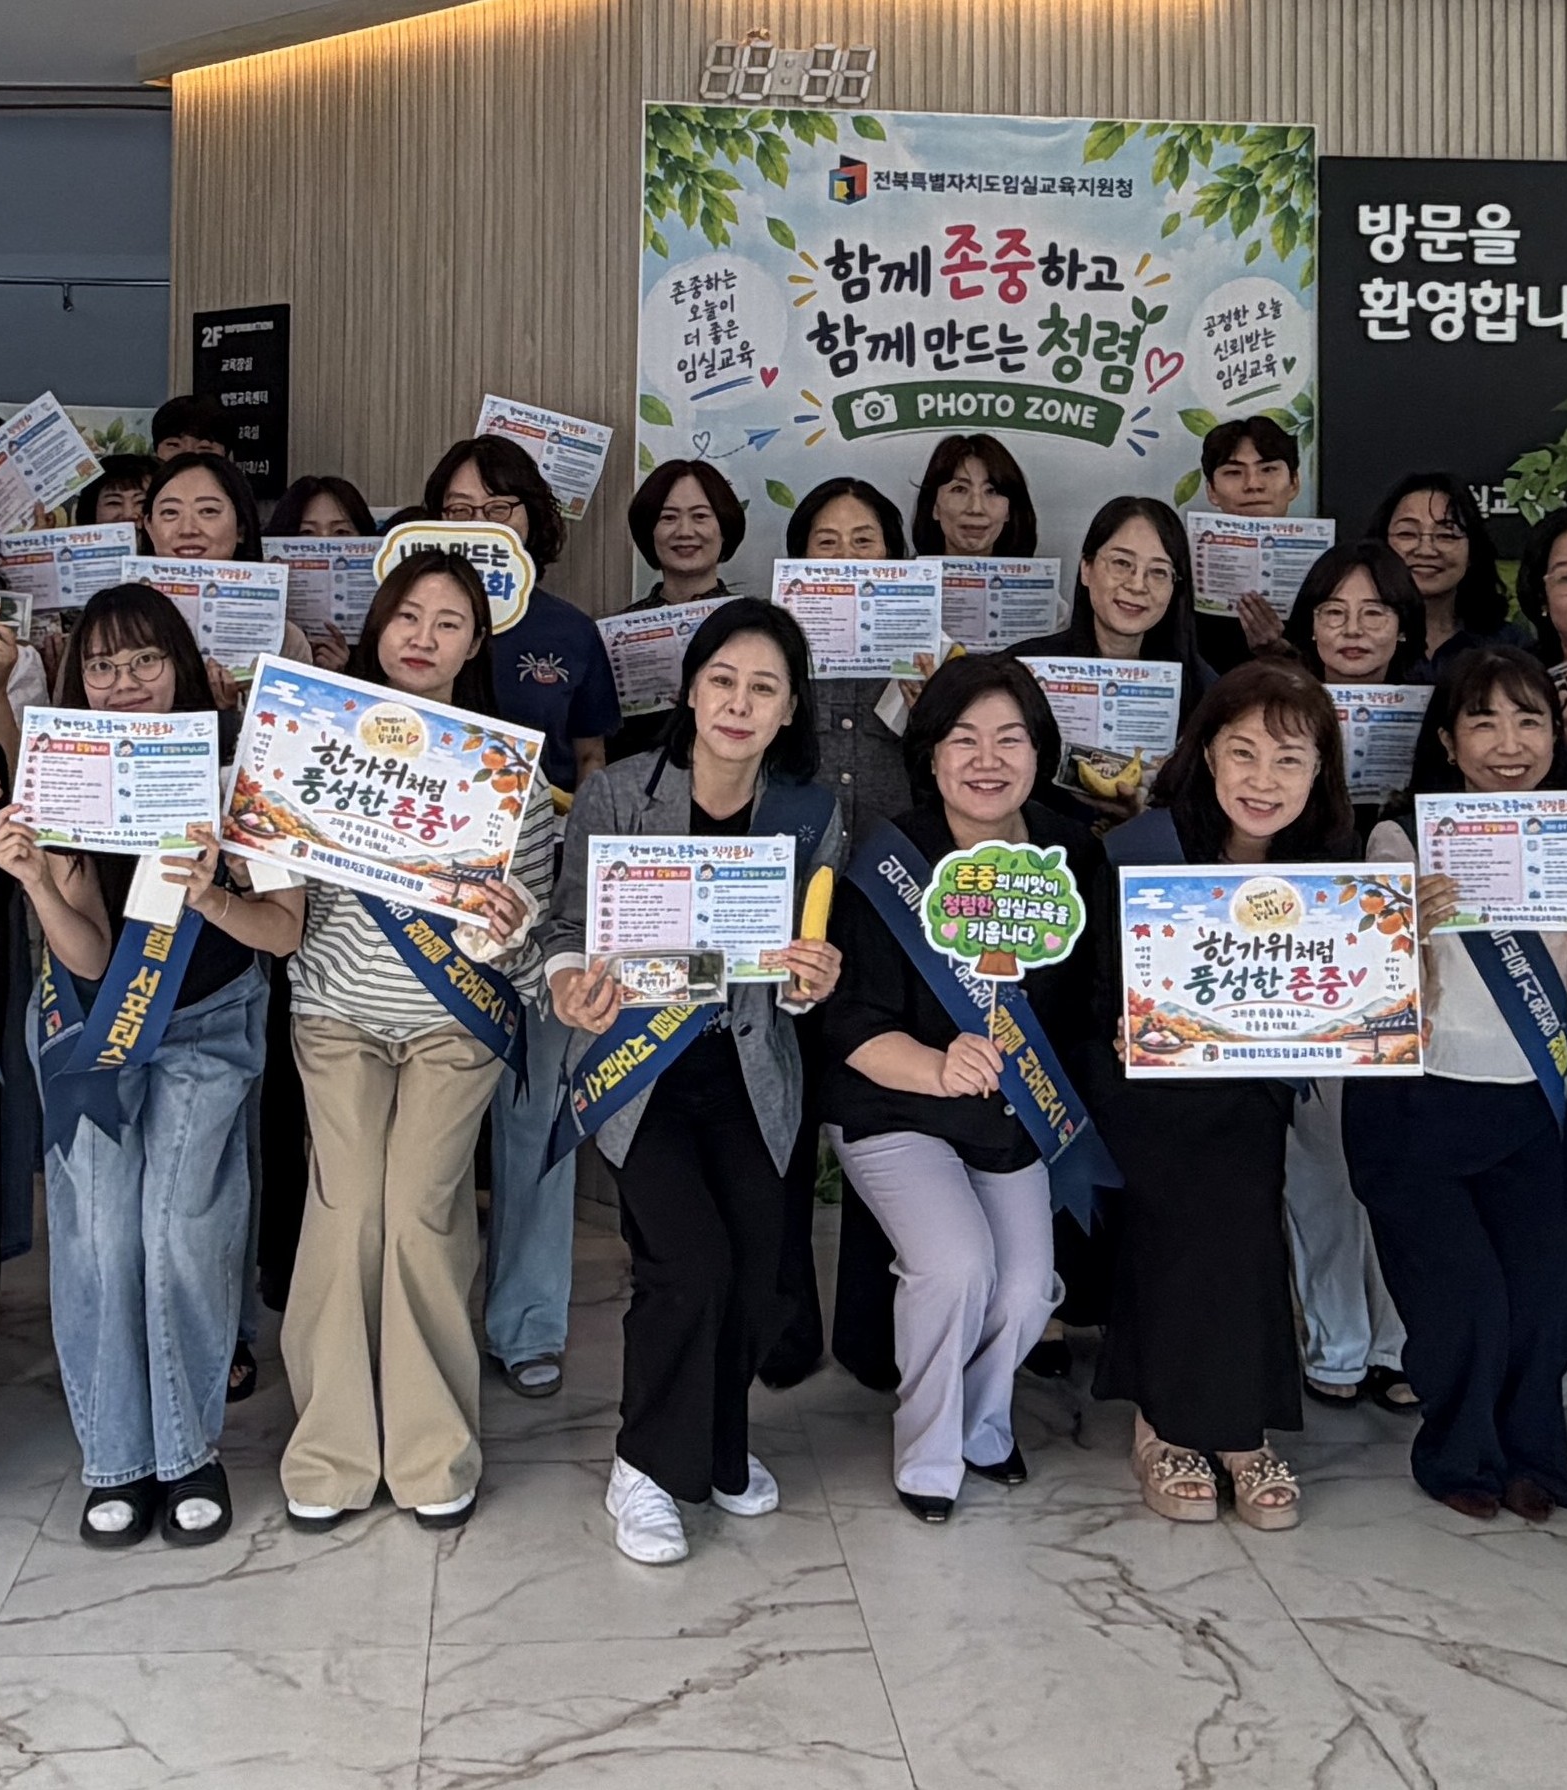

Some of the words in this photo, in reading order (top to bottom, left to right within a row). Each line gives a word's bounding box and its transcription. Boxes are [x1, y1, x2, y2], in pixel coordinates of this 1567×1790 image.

[872, 170, 1134, 200] 전북특별자치도임실교육지원청
[1357, 202, 1522, 266] 방문을
[824, 239, 932, 300] 함께
[940, 224, 1125, 304] 존중하고
[670, 268, 737, 304] 존중하는
[688, 296, 736, 324] 오늘이
[1202, 305, 1250, 335] 공정한
[1256, 298, 1284, 323] 오늘
[201, 325, 223, 348] 2F
[684, 328, 702, 347] 더
[708, 321, 740, 349] 좋은
[807, 313, 917, 377] 함께
[924, 320, 1028, 375] 만드는
[1037, 303, 1142, 394] 청렴
[1214, 325, 1277, 361] 신뢰받는
[677, 347, 756, 385] 임실교육
[1216, 355, 1278, 390] 임실교육
[917, 394, 1014, 422] PHOTO
[1024, 399, 1098, 430] ZONE
[310, 738, 448, 803] 한가위처럼
[292, 766, 389, 818] 풍성한
[387, 795, 448, 841] 존중
[954, 864, 1011, 892] 존중의
[1012, 873, 1059, 897] 씨앗이
[941, 894, 996, 918] 청렴한
[996, 897, 1071, 926] 임실교육을
[143, 924, 178, 962] 렴
[1192, 930, 1334, 967] 한가위처럼
[402, 918, 453, 965] 청렴
[444, 955, 506, 1025] 서포터스
[1183, 964, 1284, 1006] 풍성한
[1285, 966, 1348, 1005] 존중
[96, 965, 162, 1065] 서포터스
[585, 1033, 658, 1103] 서포터스
[1016, 1046, 1067, 1130] 서포터스
